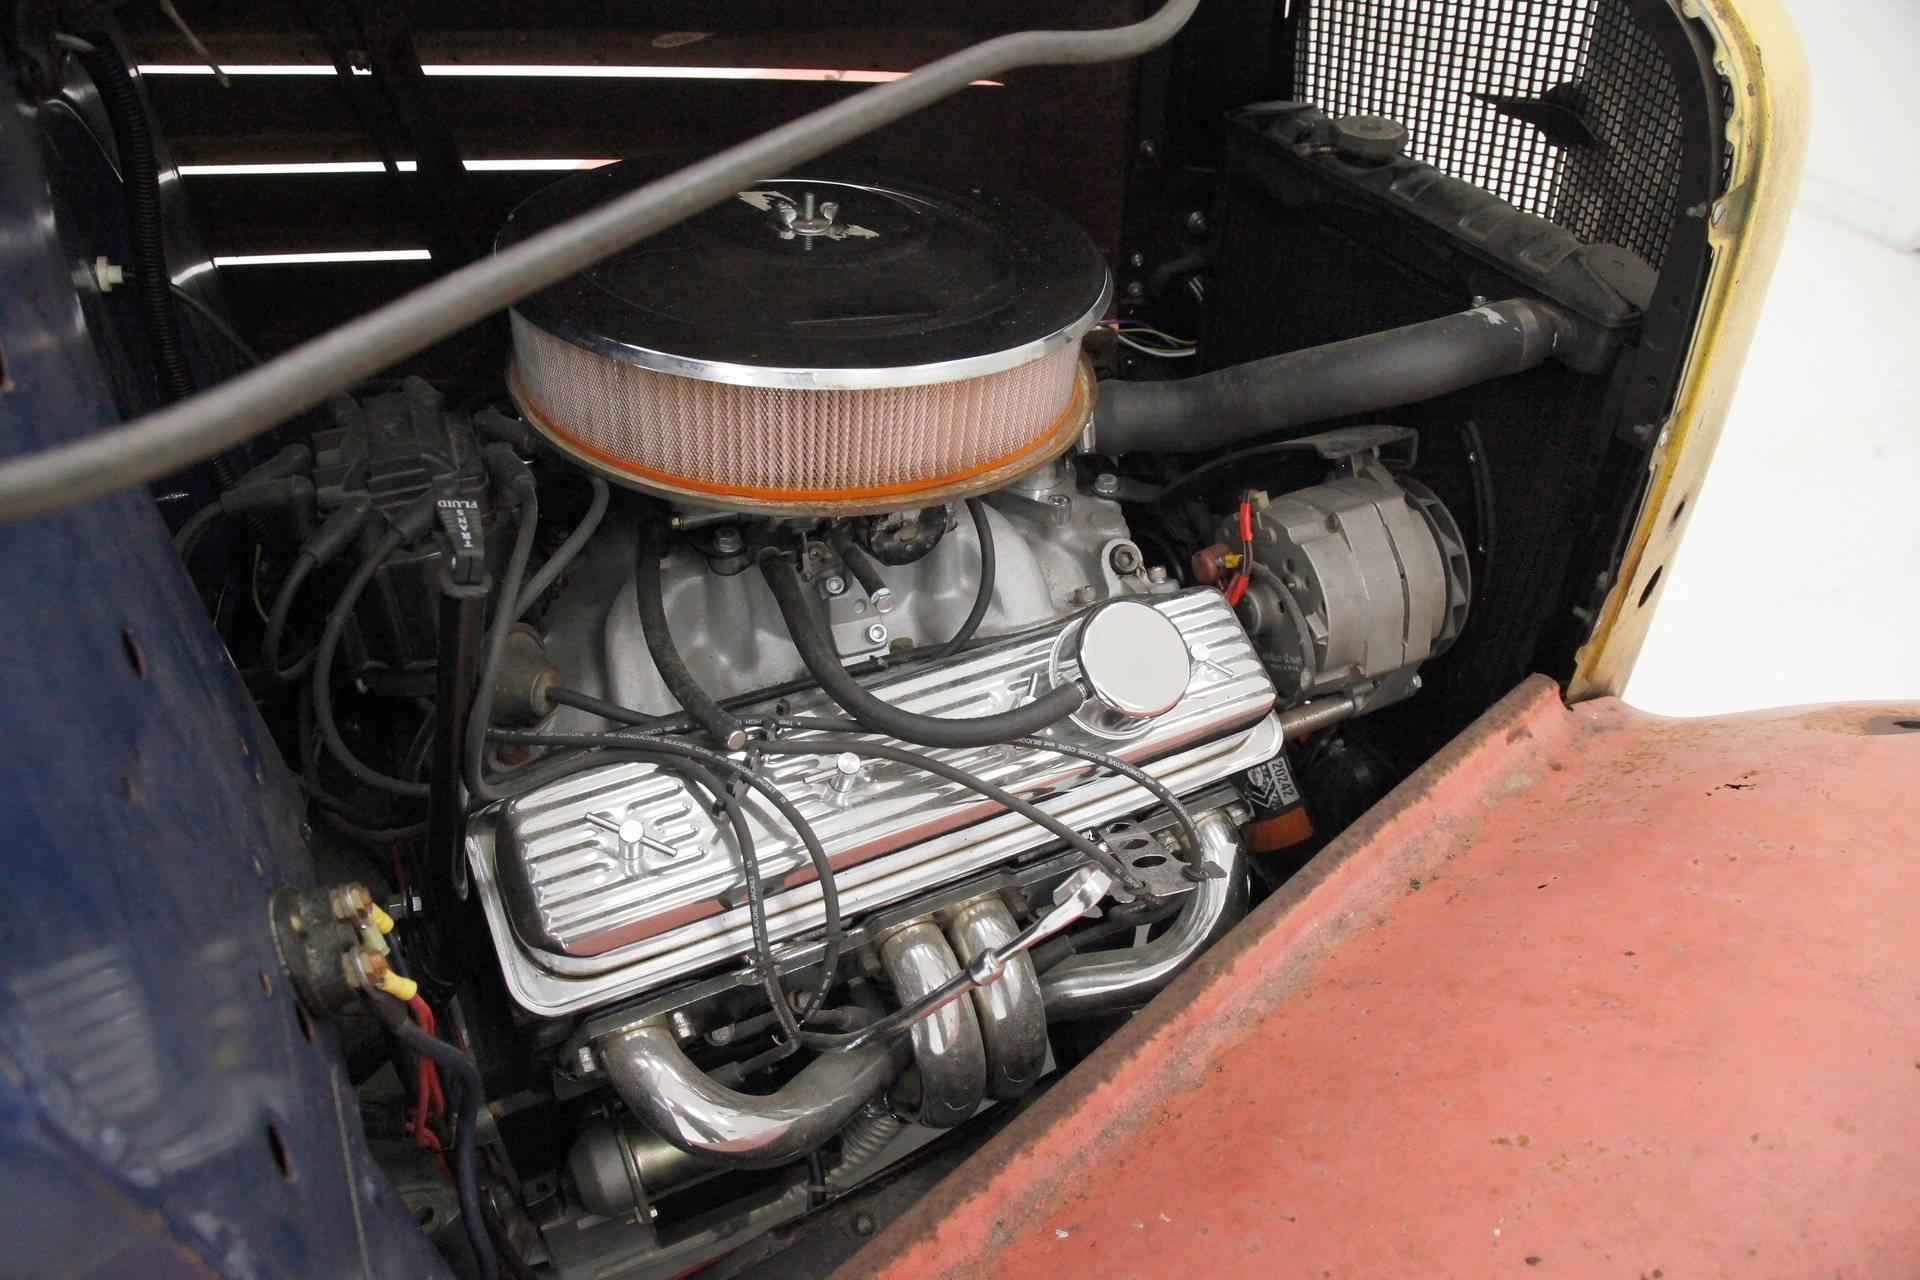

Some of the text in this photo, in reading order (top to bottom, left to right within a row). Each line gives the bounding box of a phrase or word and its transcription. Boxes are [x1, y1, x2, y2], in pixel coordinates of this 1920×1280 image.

[437, 500, 479, 509] FLUID
[456, 509, 474, 548] TRANS
[1057, 744, 1076, 753] CORE
[1077, 748, 1106, 762] SILICONE
[618, 732, 661, 743] CONDUCTIVE
[663, 738, 693, 750] SILICONE
[695, 746, 713, 757] CORE
[728, 760, 755, 777] SILICONE
[755, 777, 778, 795] JACKET
[1107, 757, 1144, 780] CONDUCTIVE
[1271, 761, 1295, 799] 20242
[748, 876, 757, 902] JACKET
[752, 905, 761, 938] SILICONE
